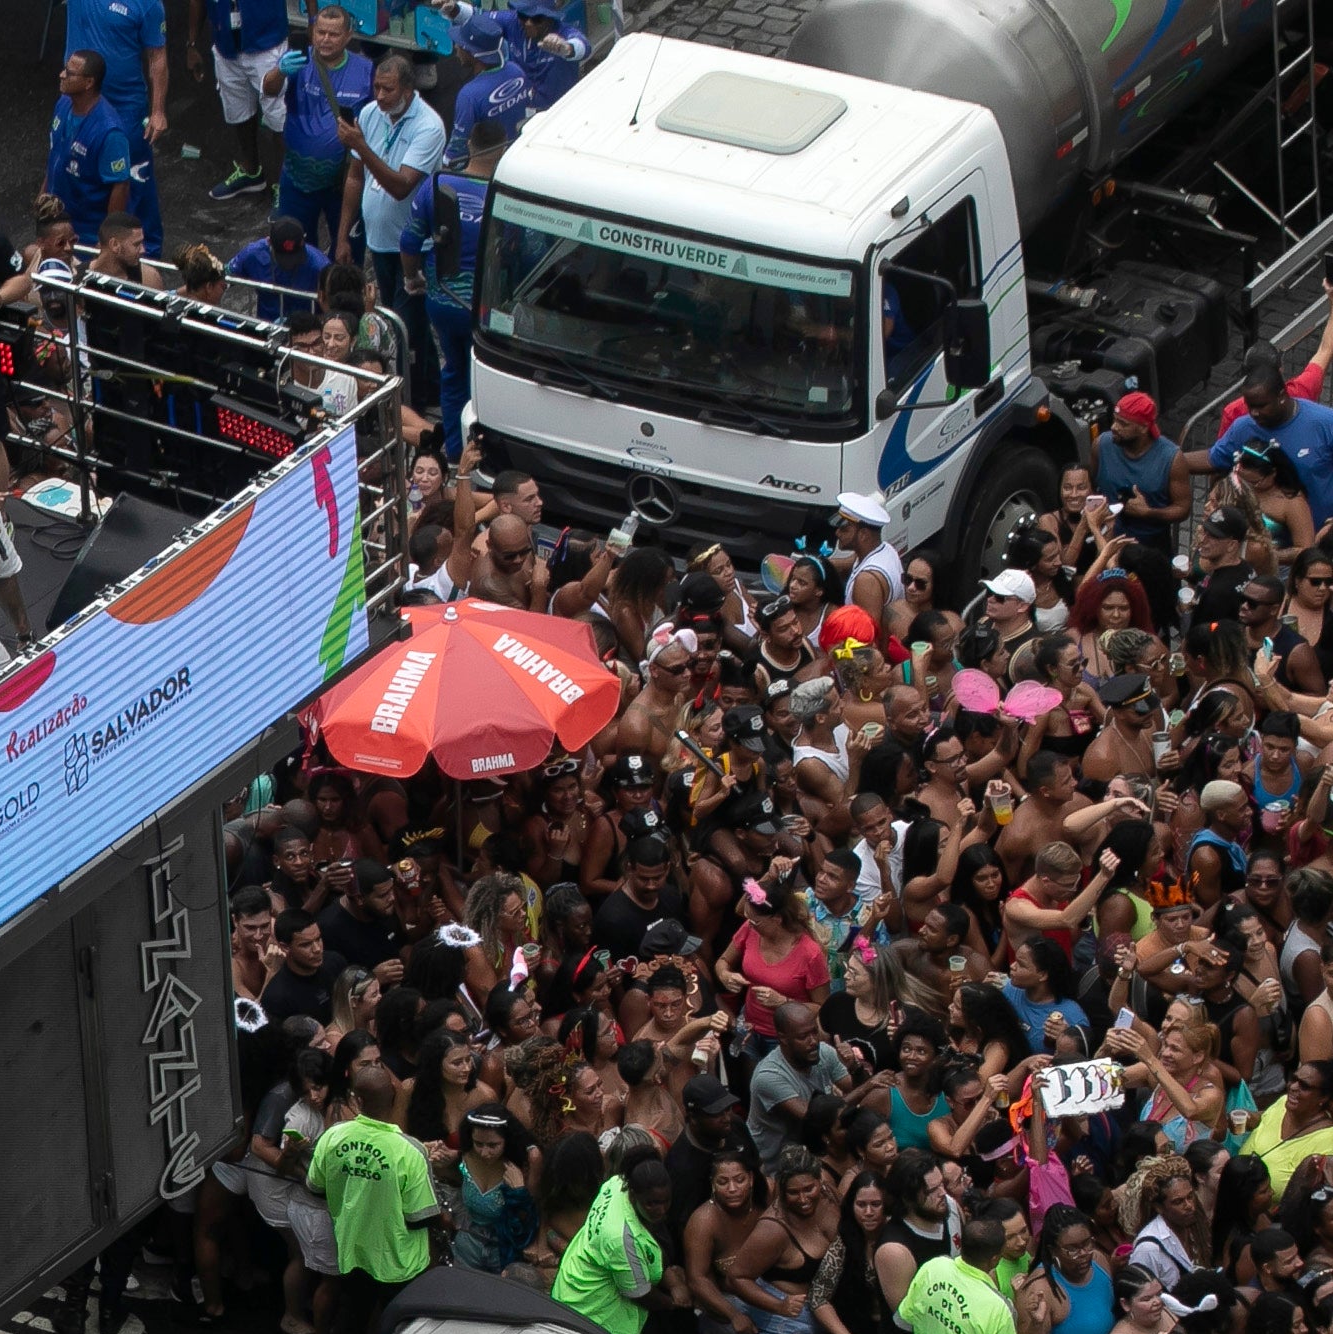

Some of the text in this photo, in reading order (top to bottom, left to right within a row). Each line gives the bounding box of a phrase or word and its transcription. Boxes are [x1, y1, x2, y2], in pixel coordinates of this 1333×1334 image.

[599, 226, 728, 269] CONSTRUVERDE
[755, 264, 837, 287] construverderio.com
[492, 633, 585, 705] BRAHMA
[370, 650, 437, 734] BRAHMA
[91, 667, 191, 754] SALVADOR
[5, 693, 88, 763] Realização
[471, 753, 515, 773] BRAHMA
[336, 1141, 390, 1171] CONTROLE
[355, 1156, 368, 1166] DE
[341, 1164, 382, 1181] ACESSO
[927, 1281, 970, 1319] CONTROLE
[941, 1298, 953, 1313] DE
[927, 1305, 962, 1334] ACESSO
